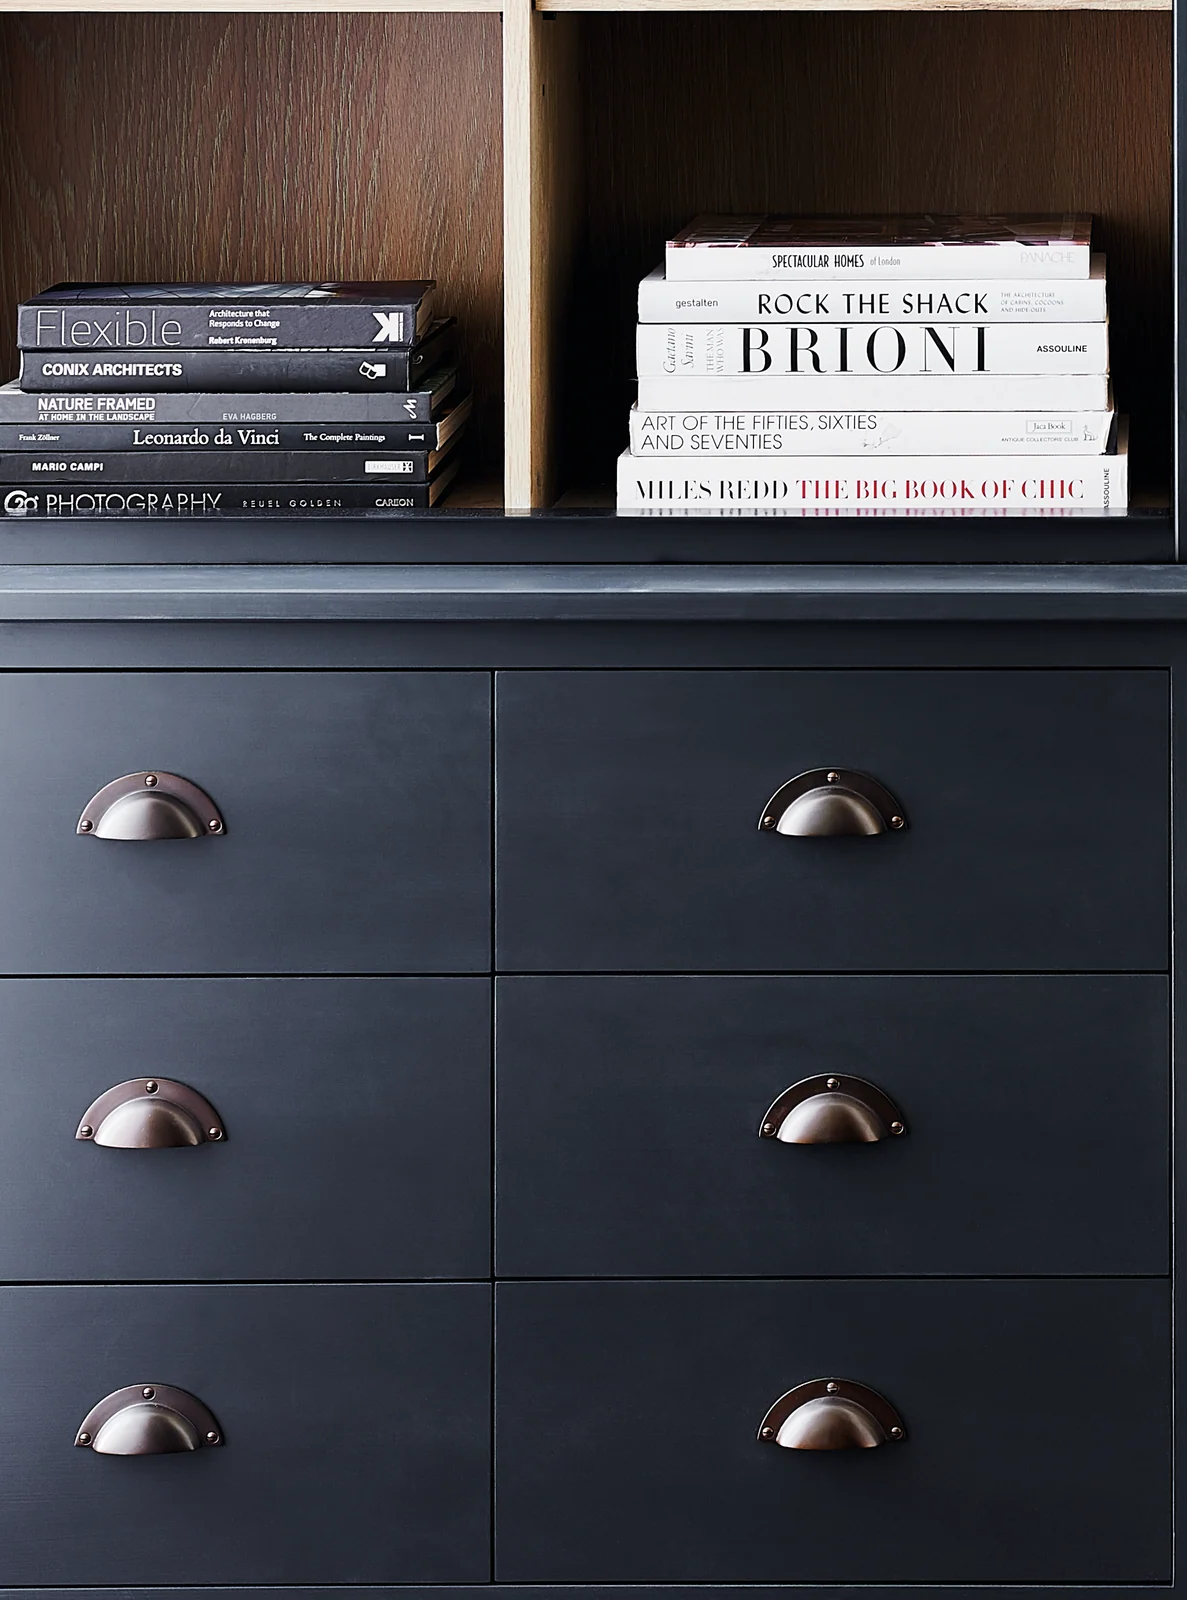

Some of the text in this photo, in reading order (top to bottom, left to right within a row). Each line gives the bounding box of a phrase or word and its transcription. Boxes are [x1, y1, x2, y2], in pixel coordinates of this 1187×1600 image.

[772, 255, 864, 268] SPECTACULAR HOMES
[675, 293, 988, 314] gestalten ROCK THE SHACK
[35, 310, 270, 346] Flexible Architecture that
[209, 320, 243, 329] Responds
[254, 320, 280, 329] Change
[208, 336, 234, 344] Robert
[737, 326, 990, 373] BRIONI
[1036, 345, 1087, 353] ASSOULINE
[42, 364, 183, 376] CONIX ARCHITECTS
[38, 398, 155, 410] NATURE FRAMED
[641, 415, 877, 431] ART OF THE FIFTIES, SIXTIES
[132, 428, 386, 445] Leonardo da Vinci The Complete Paintings
[641, 434, 783, 449] AND SEVENTIES
[32, 463, 103, 471] MARIO CAMPI
[636, 480, 1083, 499] MILES REDD THE BIG BOOK OF CHIC
